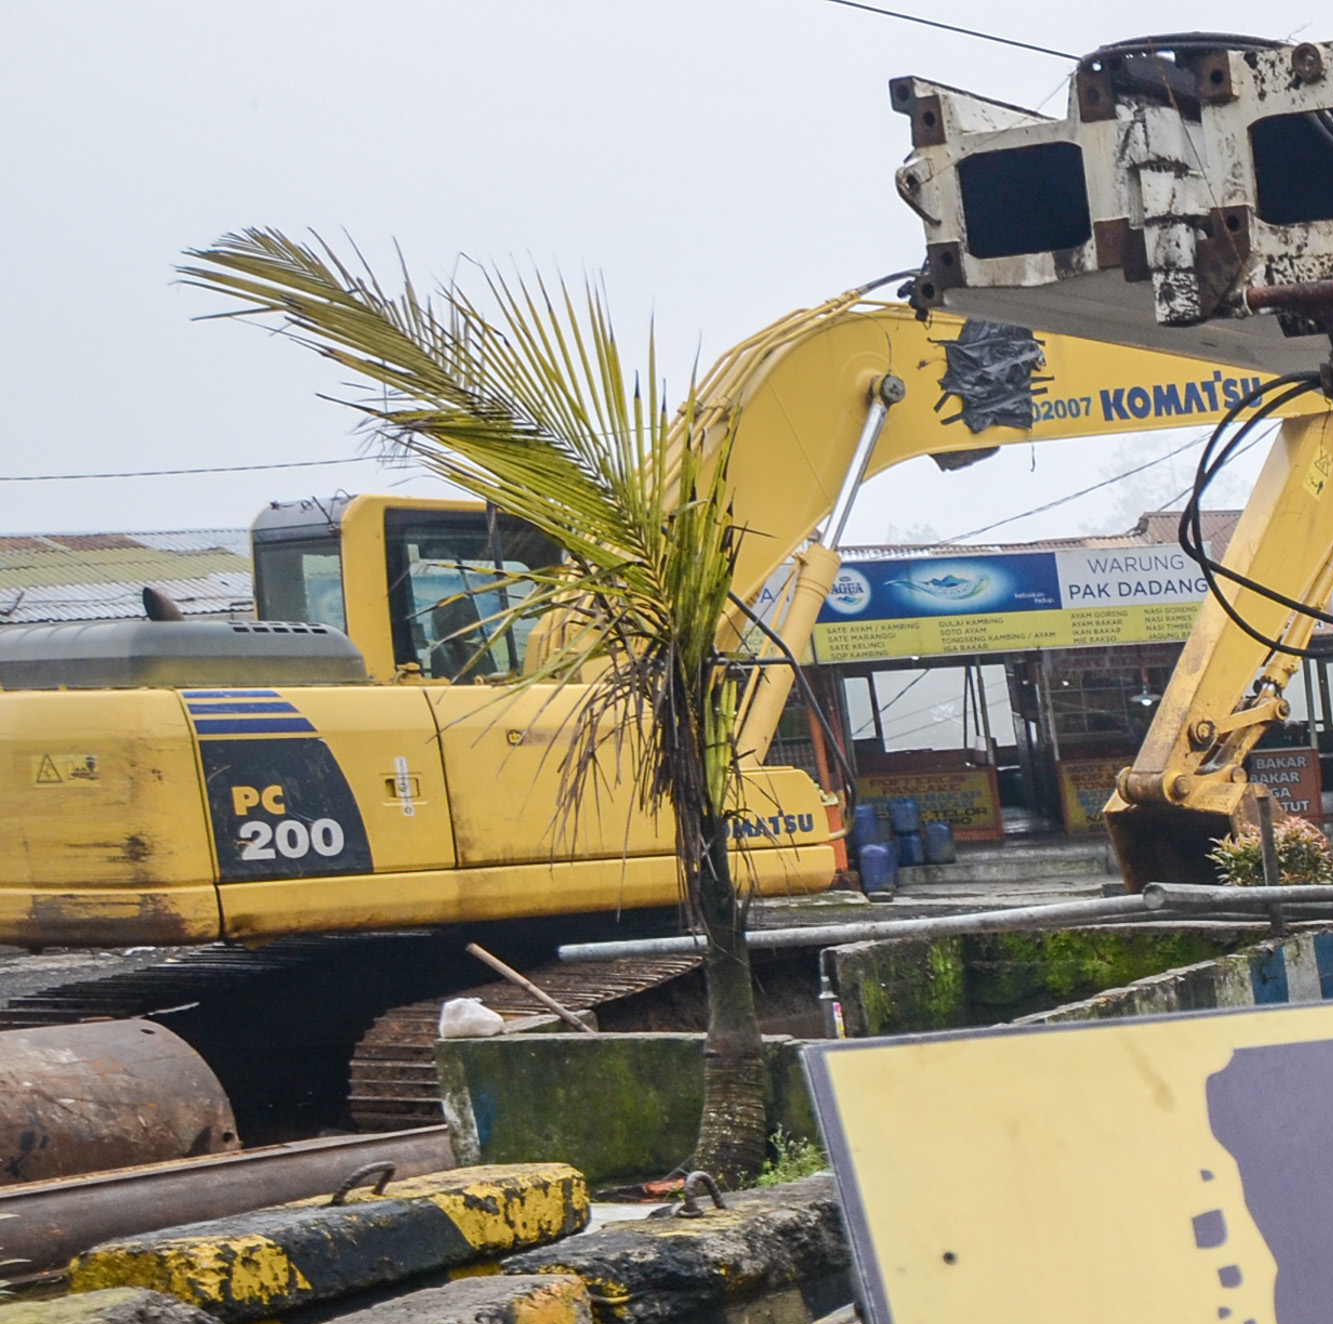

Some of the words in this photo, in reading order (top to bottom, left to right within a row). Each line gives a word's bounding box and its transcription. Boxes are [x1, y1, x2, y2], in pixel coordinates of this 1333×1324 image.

[1100, 371, 1263, 421] KOMATSU
[1087, 554, 1185, 574] WARUNG
[831, 582, 864, 595] AQUA
[1068, 583, 1111, 600] PAK
[1118, 577, 1208, 597] DADANG
[1094, 610, 1128, 618] GORENG
[1144, 607, 1162, 615] NASI
[881, 622, 920, 630] KAMBING
[966, 617, 1004, 625] KAMBING
[1095, 618, 1123, 626] BAKAR
[940, 628, 962, 636] SOTO
[941, 635, 986, 644] TONGSENG
[988, 633, 1026, 641] KAMBING
[1089, 635, 1116, 643] BAKSO
[960, 643, 988, 651] BAKAR
[831, 652, 848, 660] SOP
[850, 650, 889, 658] KAMBING
[1256, 756, 1306, 769] BAKAR
[1250, 772, 1300, 784] BAKAR
[1270, 787, 1291, 798] GA
[231, 785, 286, 816] PC
[1281, 800, 1309, 812] TUT
[725, 810, 813, 839] MATSU
[239, 818, 345, 861] 200
